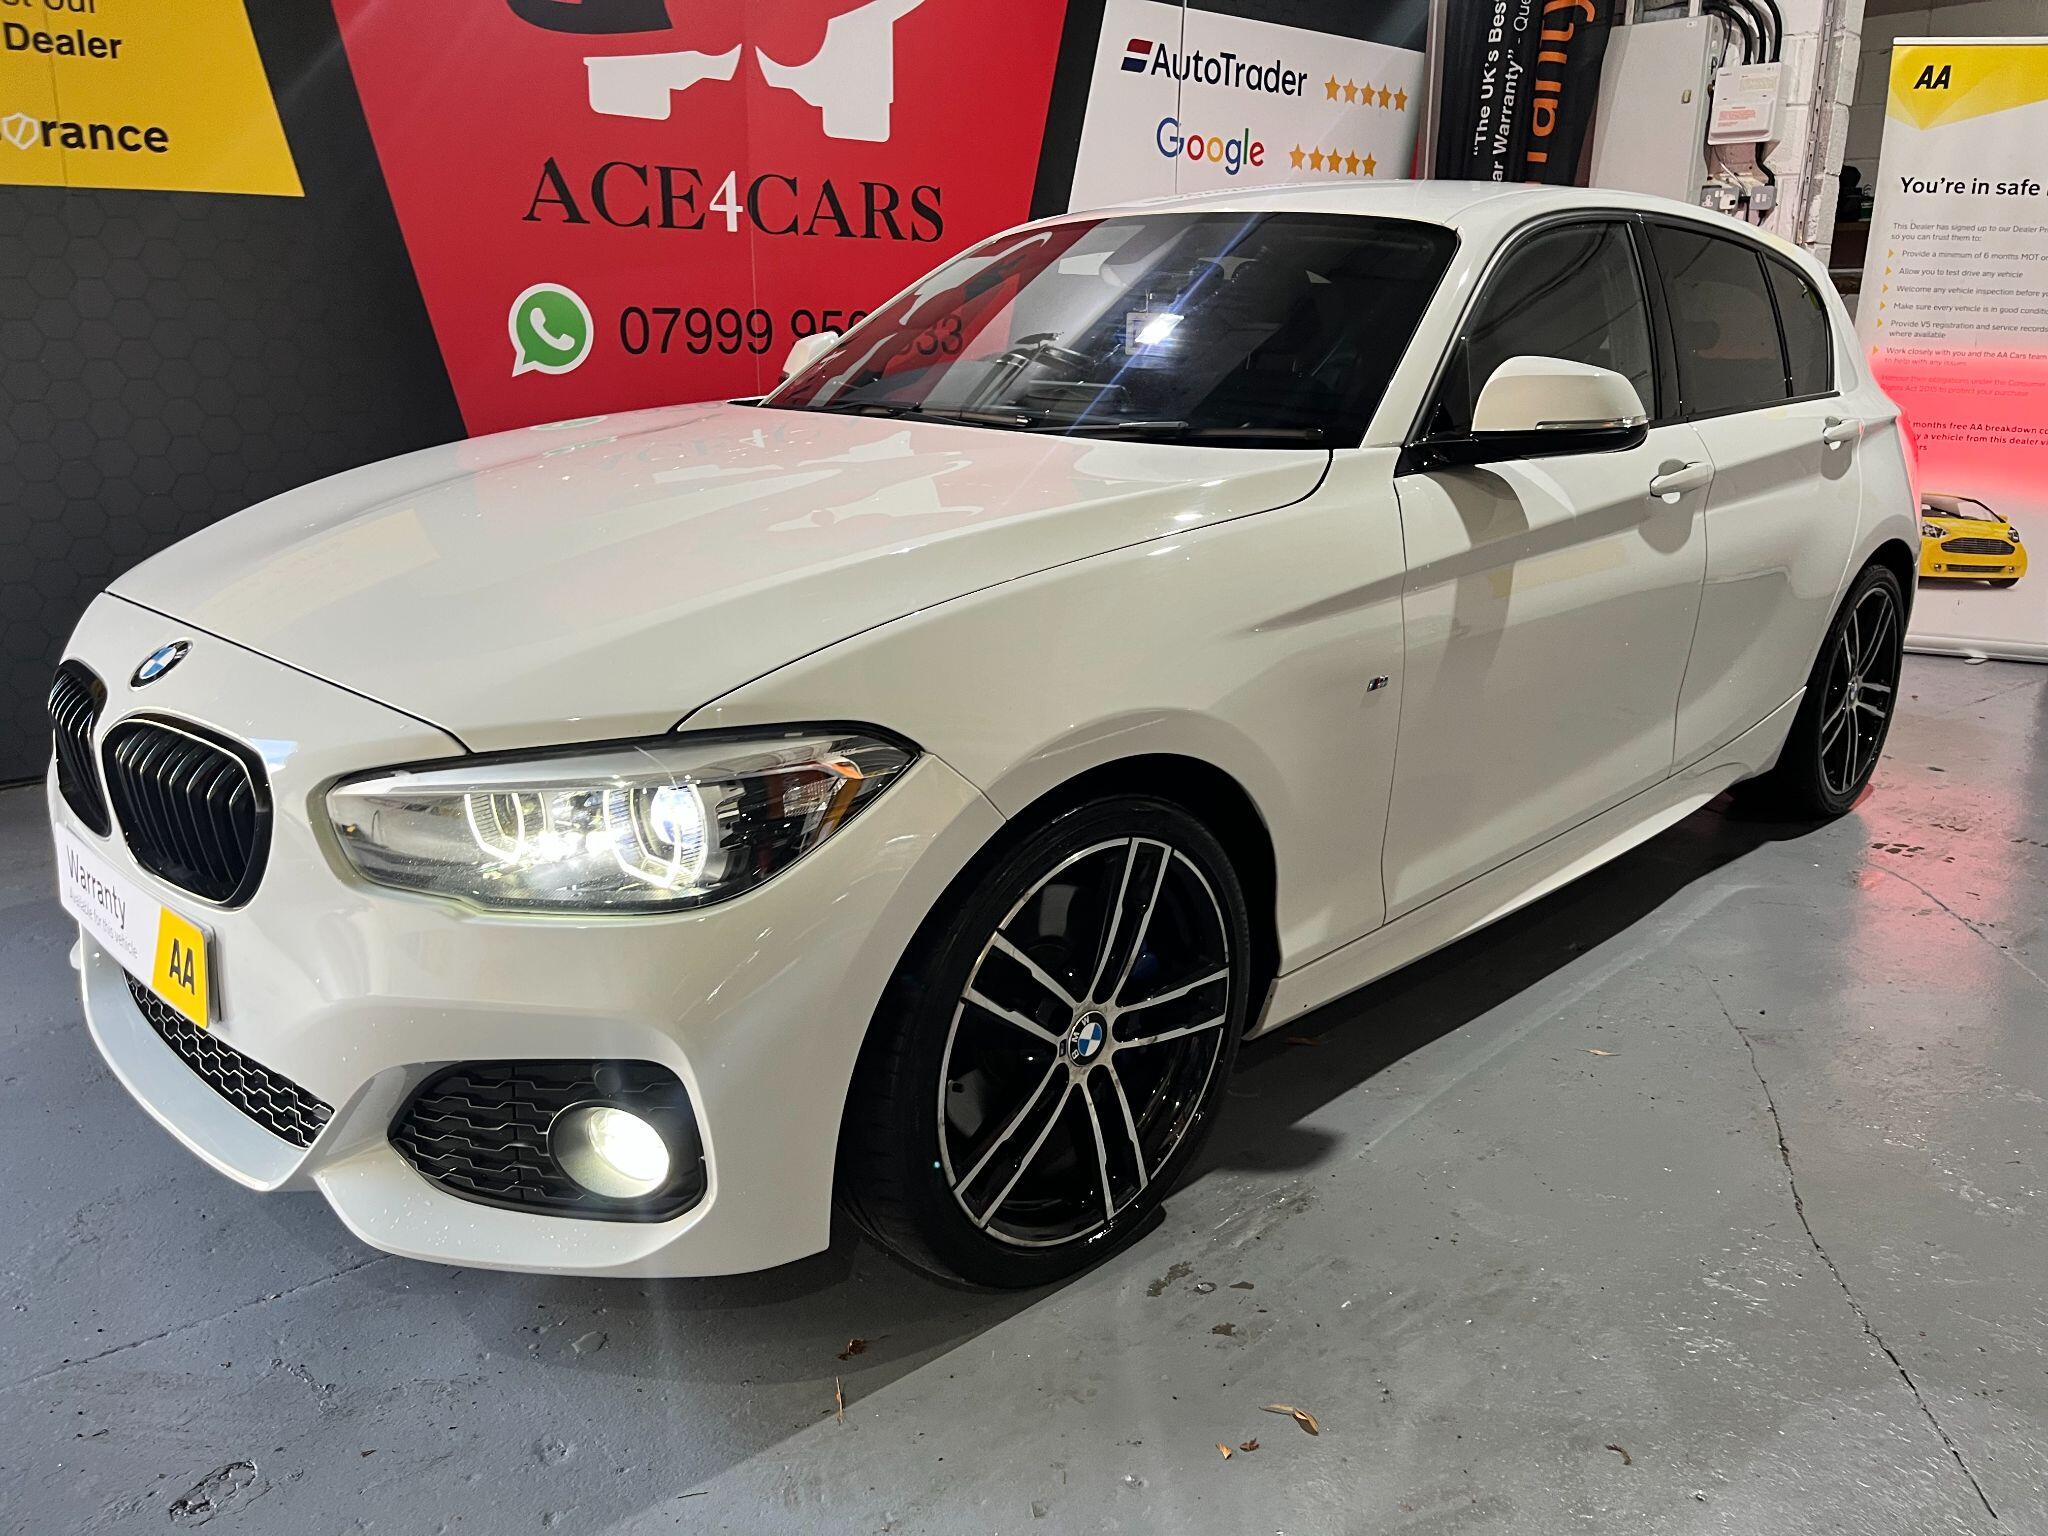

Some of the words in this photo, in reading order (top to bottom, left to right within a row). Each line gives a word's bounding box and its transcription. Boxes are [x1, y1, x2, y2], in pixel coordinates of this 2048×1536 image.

[3, 22, 122, 59] Dealer
[1488, 0, 1507, 43] Bes
[1151, 43, 1308, 97] AutoTrader
[1913, 65, 1951, 89] AA
[1156, 117, 1265, 176] Google
[1492, 161, 1504, 183] ar
[1901, 177, 1966, 194] You’re
[1971, 178, 1990, 195] in
[1996, 178, 2041, 196] safe
[521, 156, 944, 242] ACE4CARS
[1902, 250, 1930, 258] Provide
[1954, 304, 1981, 312] vehicle
[620, 305, 773, 355] 07999
[1986, 424, 2036, 434] breakdown
[2010, 438, 2038, 446] dealer
[66, 844, 126, 930] Warranty
[169, 938, 195, 995] AA
[1071, 1015, 1090, 1060] BMW
